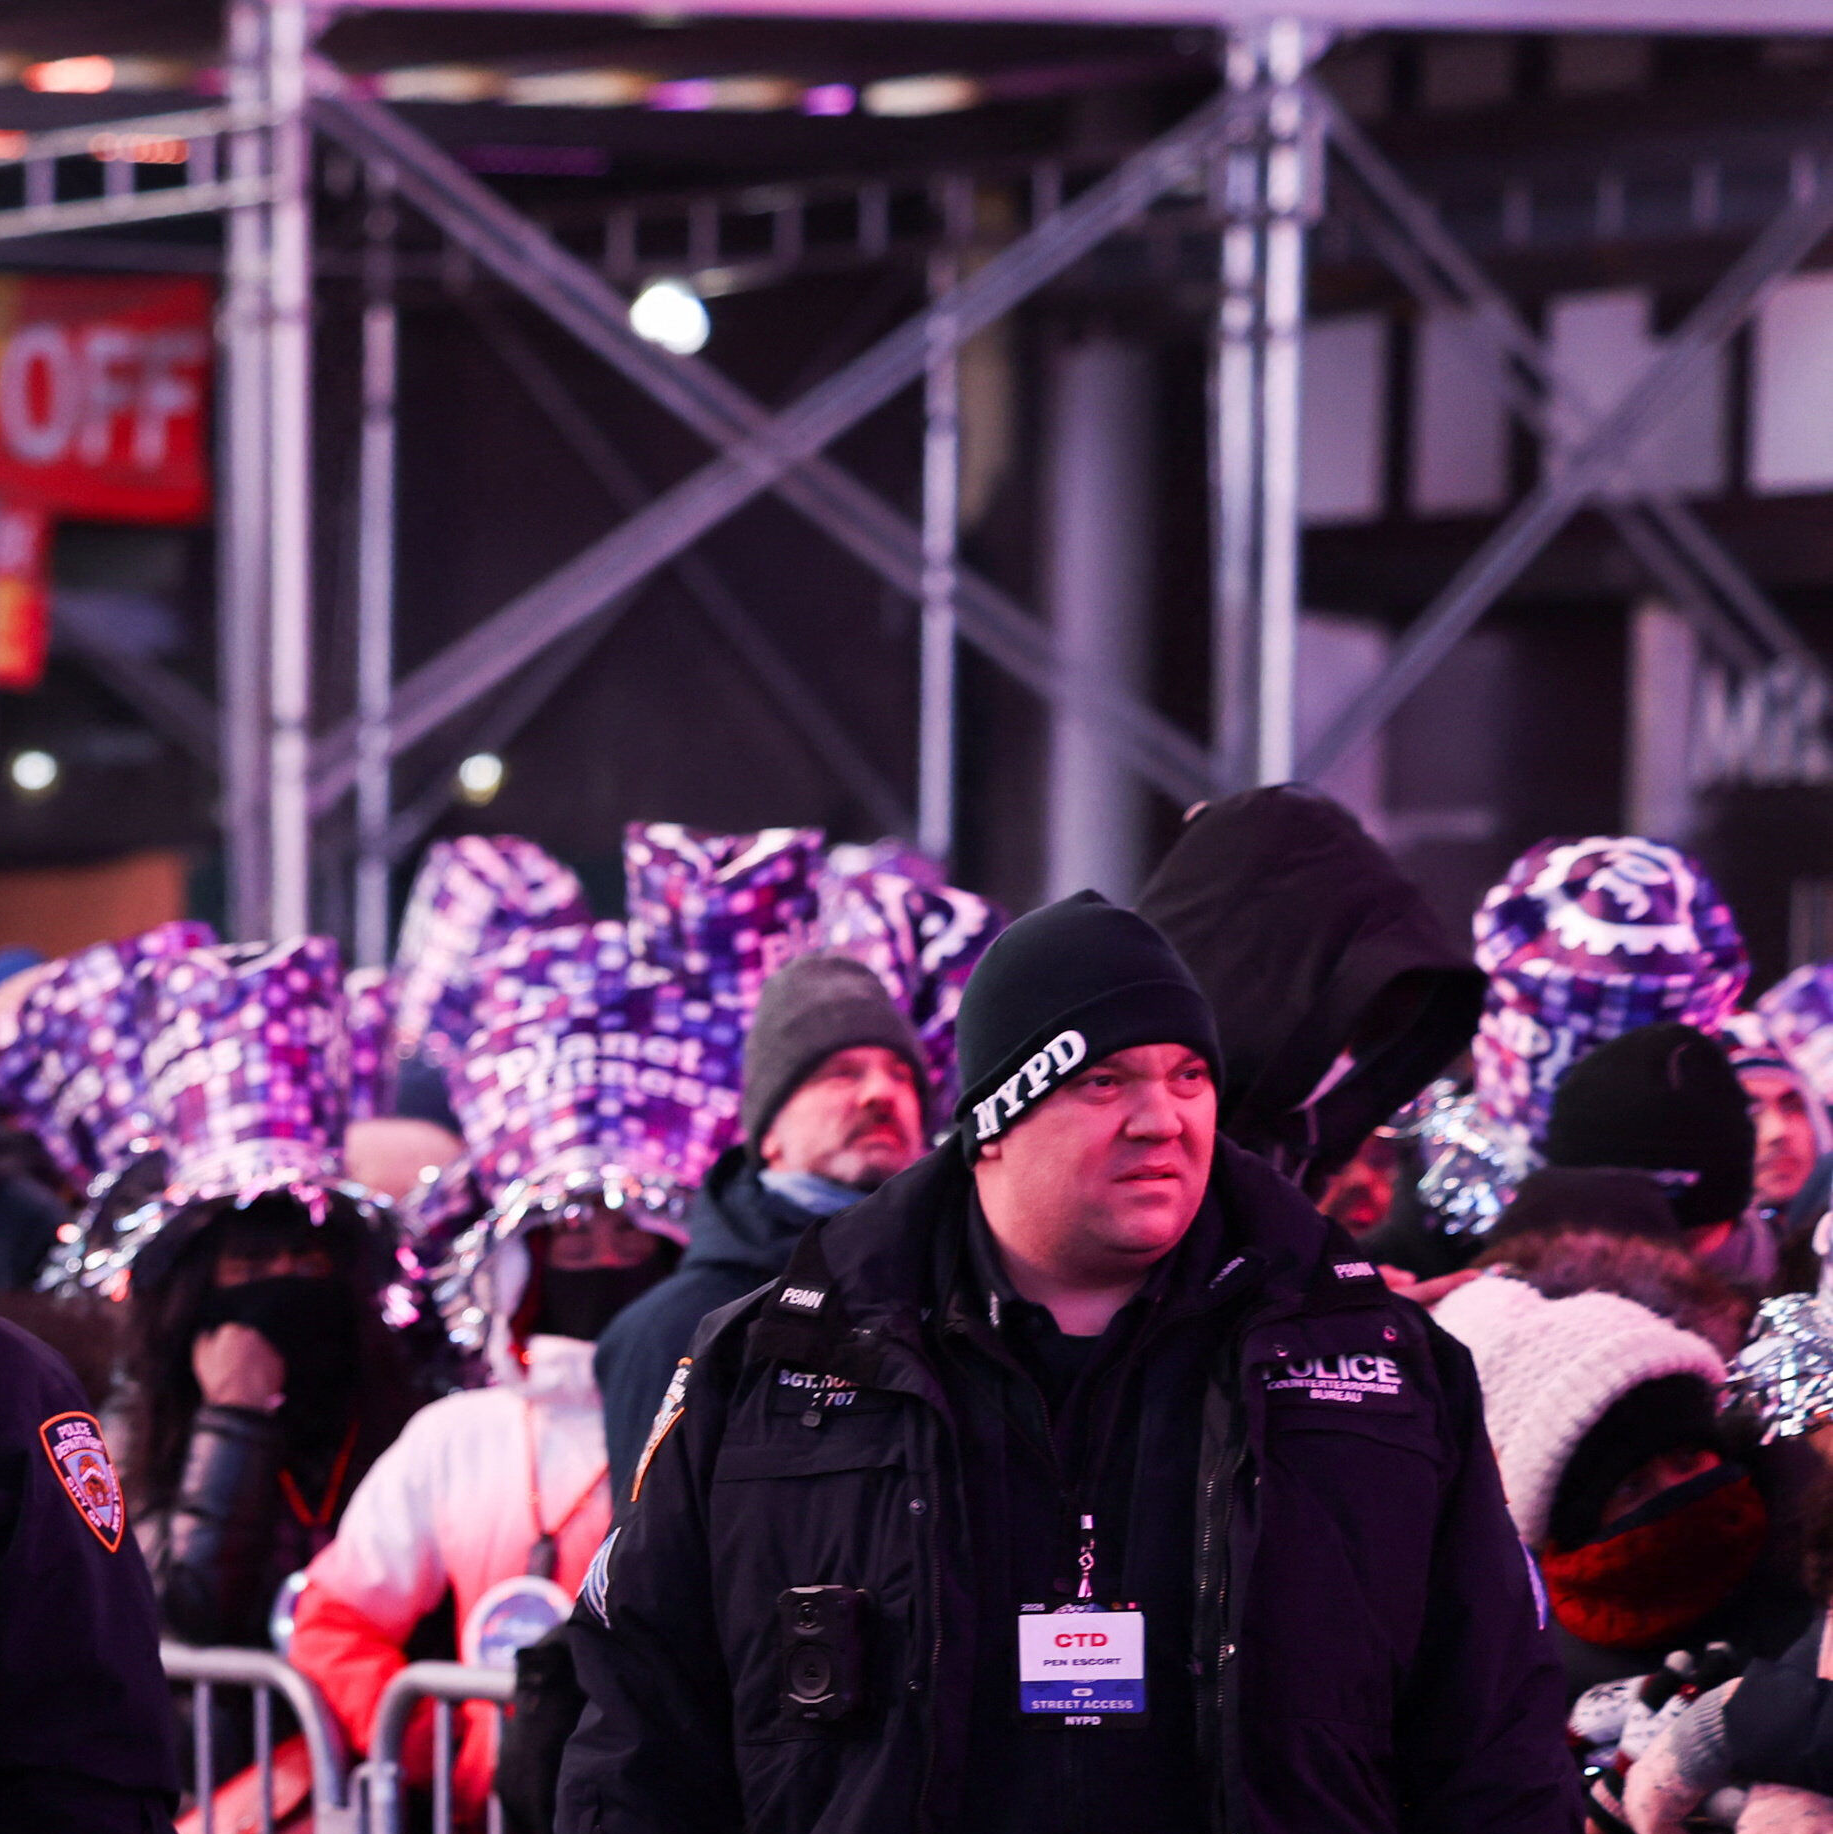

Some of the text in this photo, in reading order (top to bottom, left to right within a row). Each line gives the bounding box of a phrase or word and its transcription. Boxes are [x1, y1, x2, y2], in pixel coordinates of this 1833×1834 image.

[973, 1029, 1087, 1140] NYPD
[779, 1287, 826, 1309] PBMN
[1309, 1388, 1363, 1403] BUREAU
[56, 1421, 93, 1440] POLICE
[1054, 1633, 1109, 1648] CTD
[1043, 1657, 1122, 1667] PEN ESCORT
[1030, 1699, 1134, 1710] STREET ACCESS
[1064, 1715, 1102, 1726] NYPD
